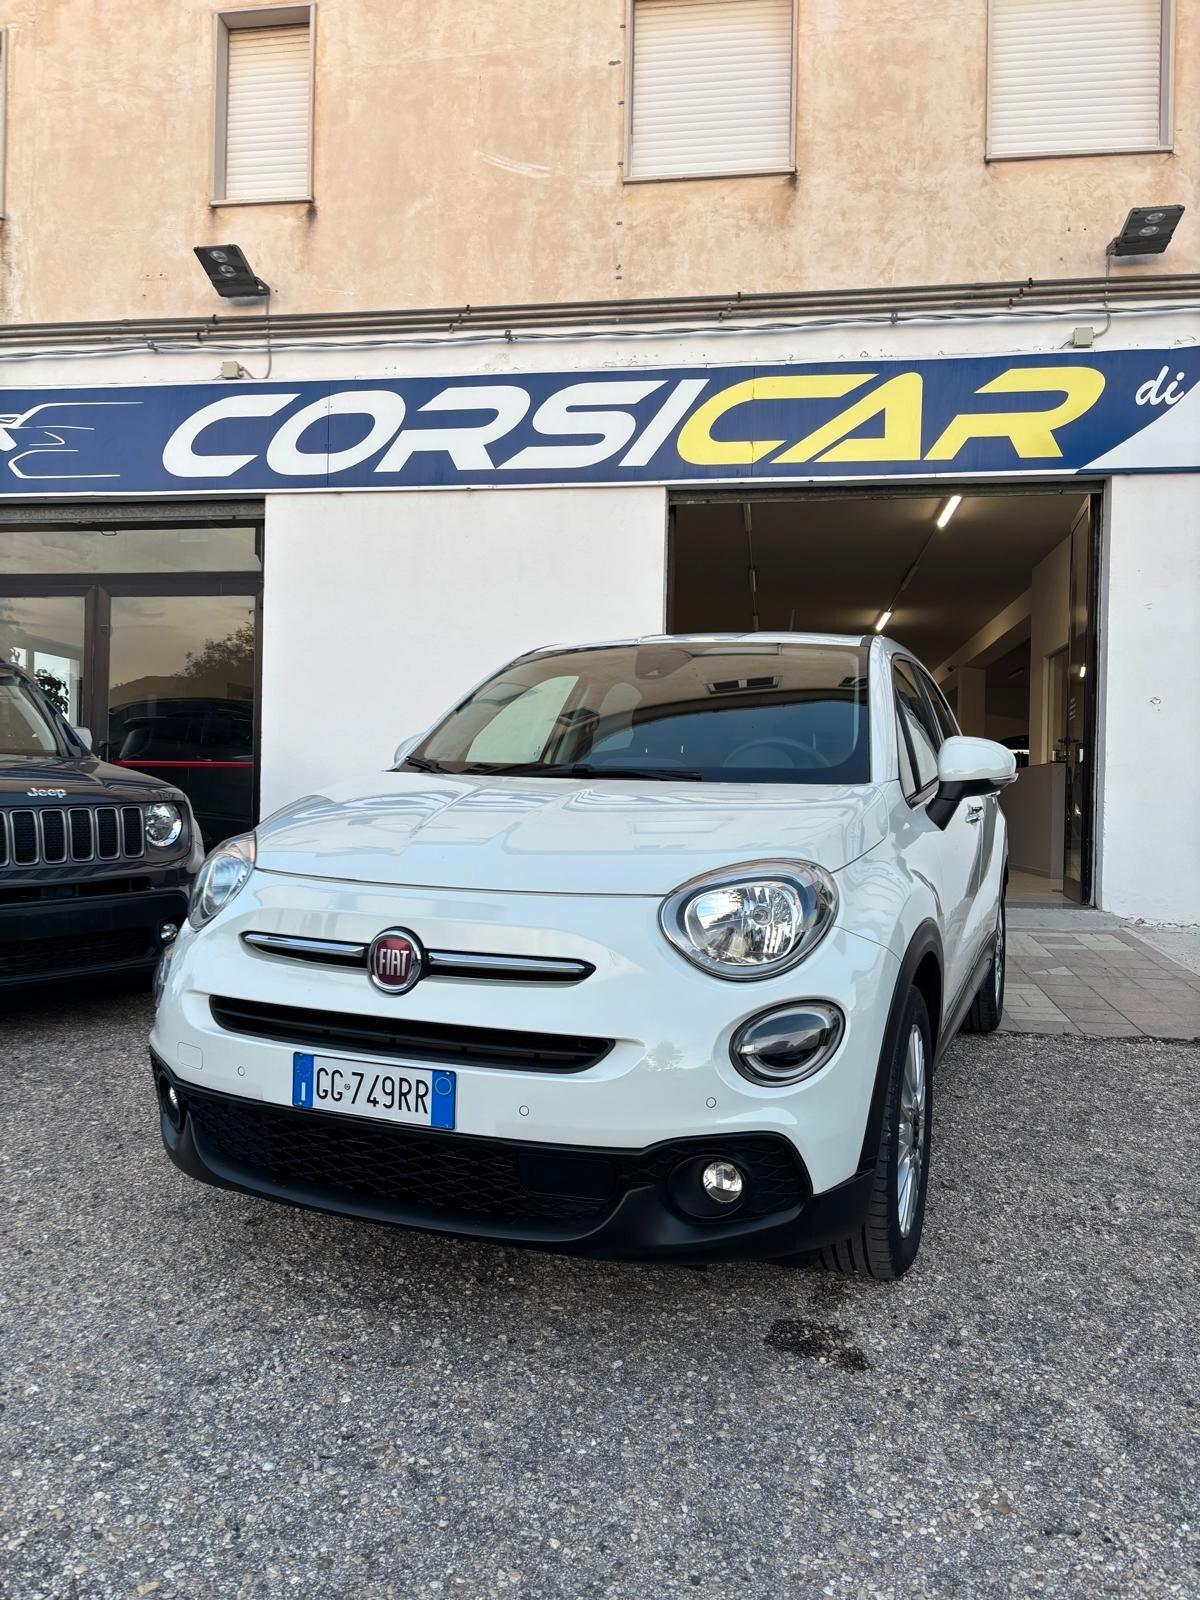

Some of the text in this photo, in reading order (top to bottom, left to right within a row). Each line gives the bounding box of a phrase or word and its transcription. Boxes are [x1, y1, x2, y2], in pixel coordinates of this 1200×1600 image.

[1135, 365, 1185, 406] di
[27, 787, 67, 799] Jeep
[379, 949, 410, 977] FIAT
